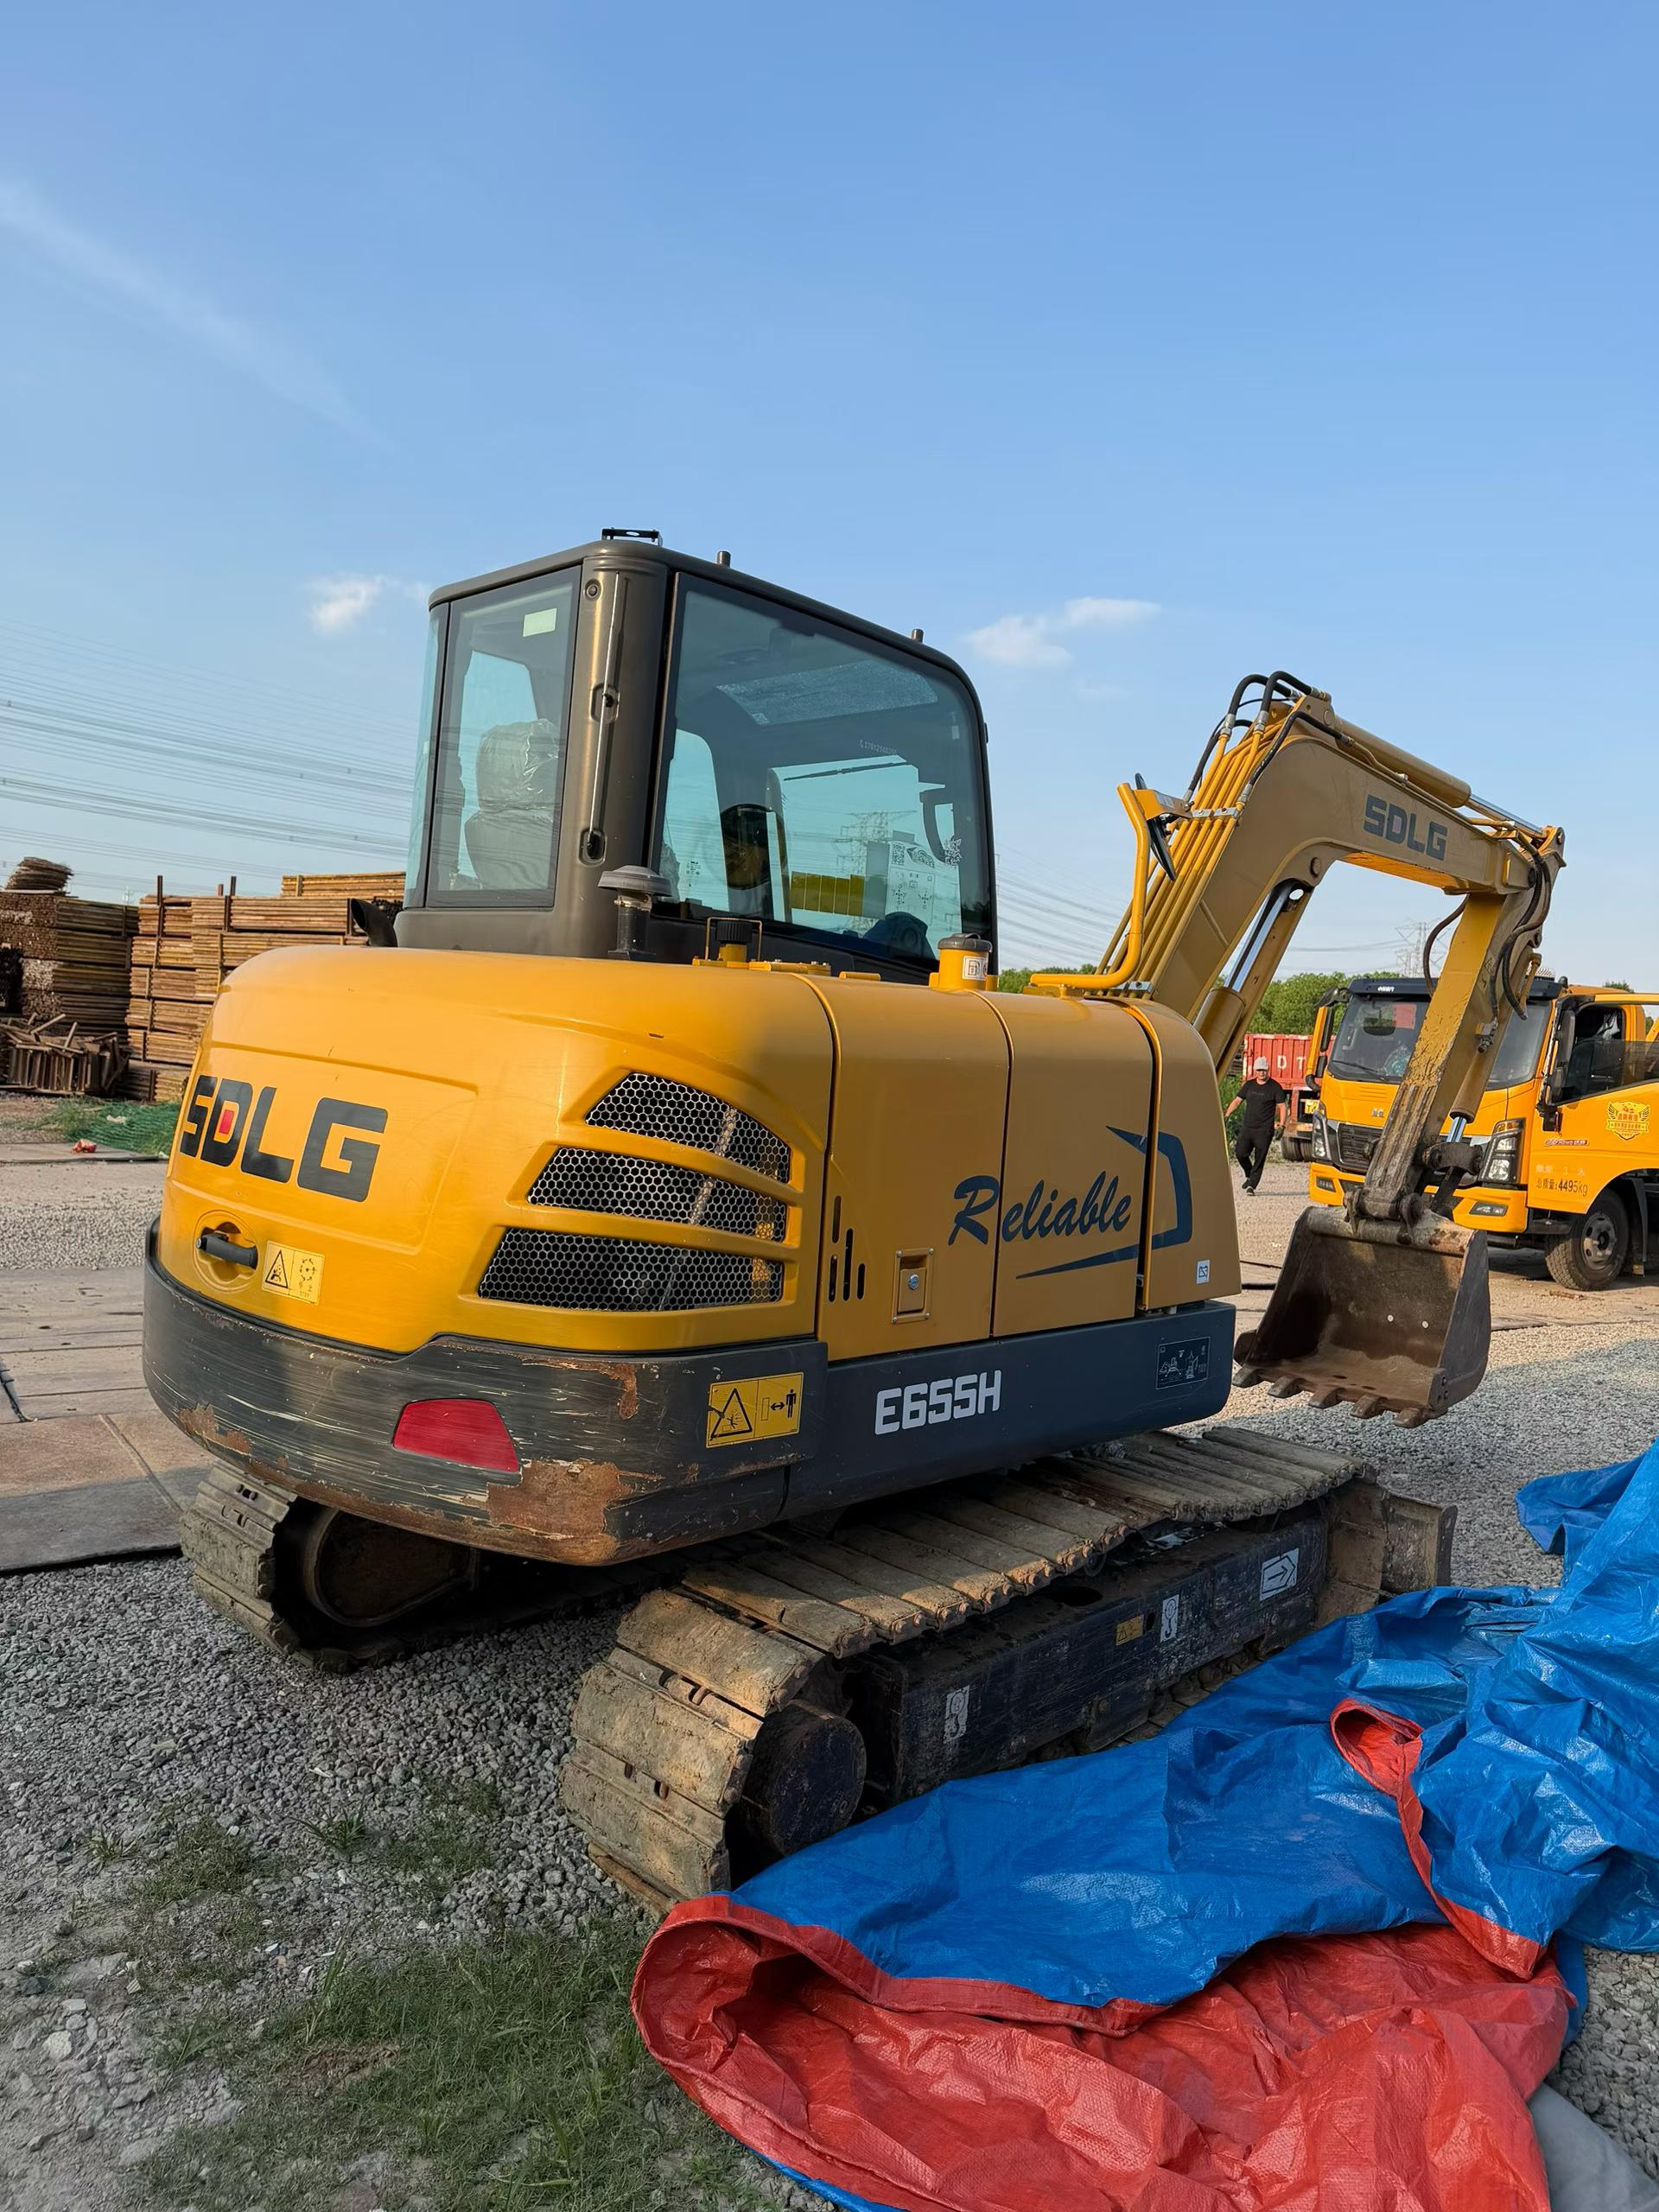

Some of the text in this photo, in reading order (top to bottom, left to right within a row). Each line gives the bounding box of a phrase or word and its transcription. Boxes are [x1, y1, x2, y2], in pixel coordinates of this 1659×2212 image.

[1363, 794, 1448, 861] SDLG
[179, 1075, 388, 1202] SDLG
[948, 1171, 1132, 1246] Reliable
[874, 1370, 1002, 1435] E655H
